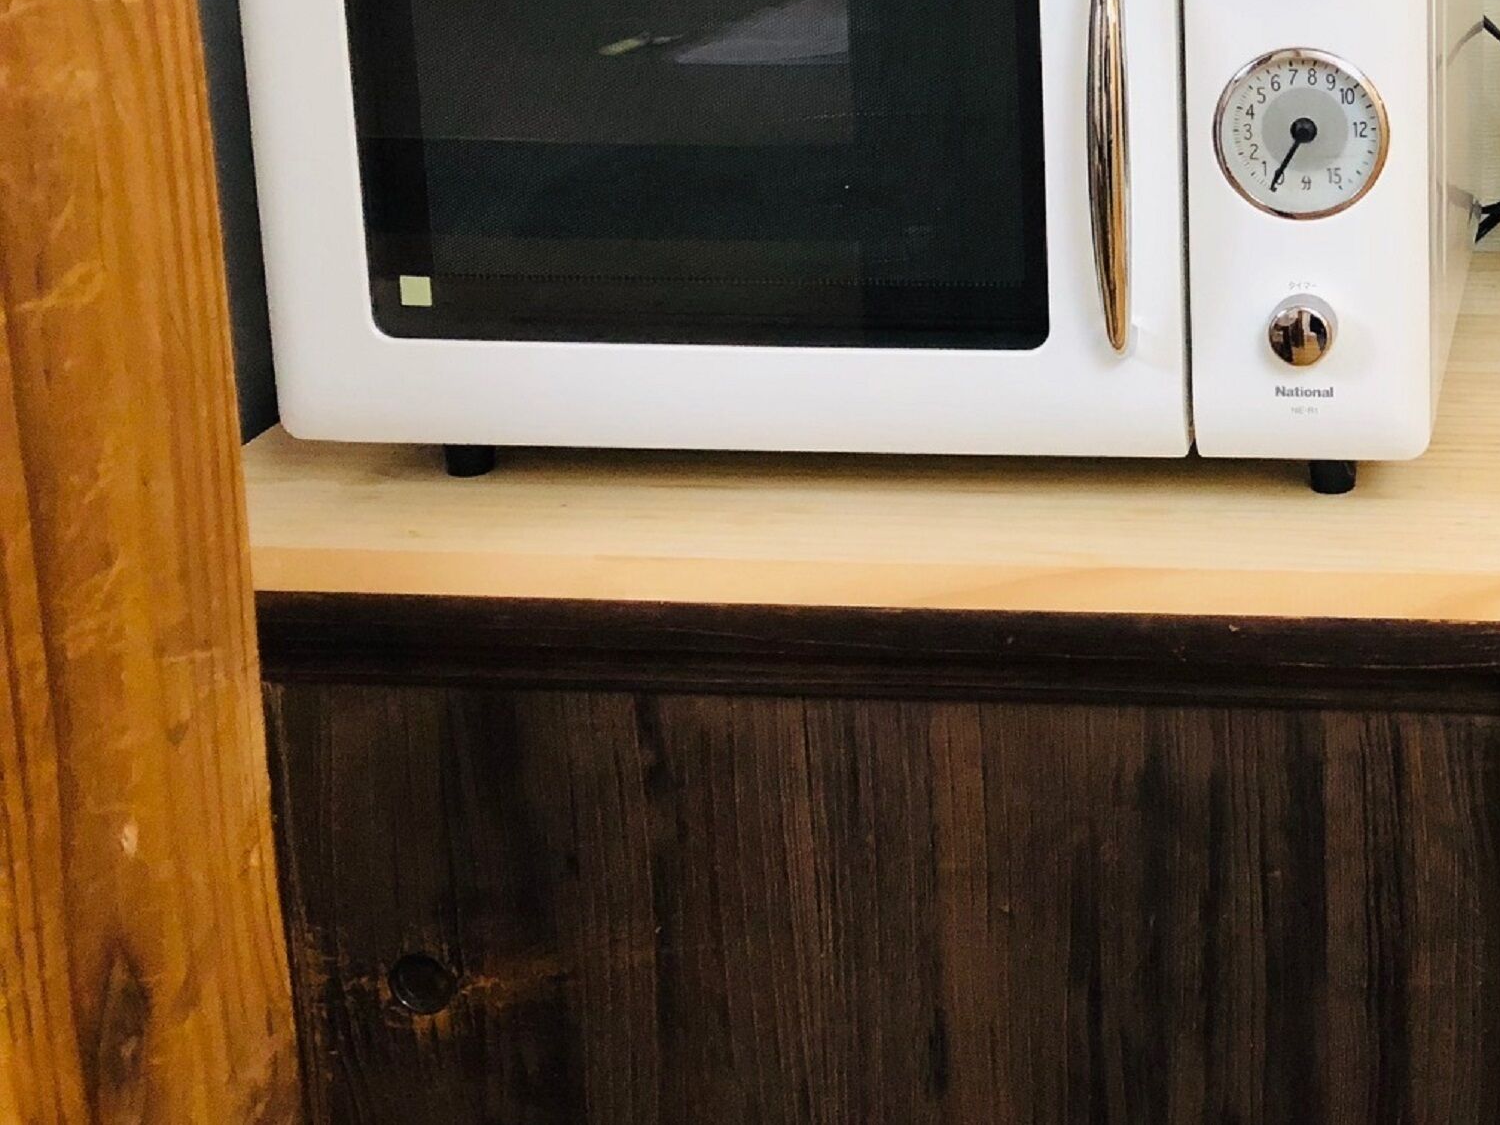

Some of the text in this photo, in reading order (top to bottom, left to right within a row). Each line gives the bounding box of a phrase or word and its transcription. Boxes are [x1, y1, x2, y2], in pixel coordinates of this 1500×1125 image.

[1270, 74, 1281, 91] 6
[1289, 69, 1299, 85] 7
[1307, 68, 1317, 85] 8
[1326, 74, 1336, 91] 9
[1256, 87, 1266, 104] 5
[1340, 88, 1355, 105] 10
[1245, 104, 1255, 120] 4
[1243, 123, 1252, 140] 3
[1353, 122, 1368, 138] 12
[1250, 144, 1259, 160] 2
[1262, 161, 1267, 176] 1
[1327, 167, 1342, 184] 15
[1301, 175, 1312, 190] 分
[1275, 385, 1334, 398] National
